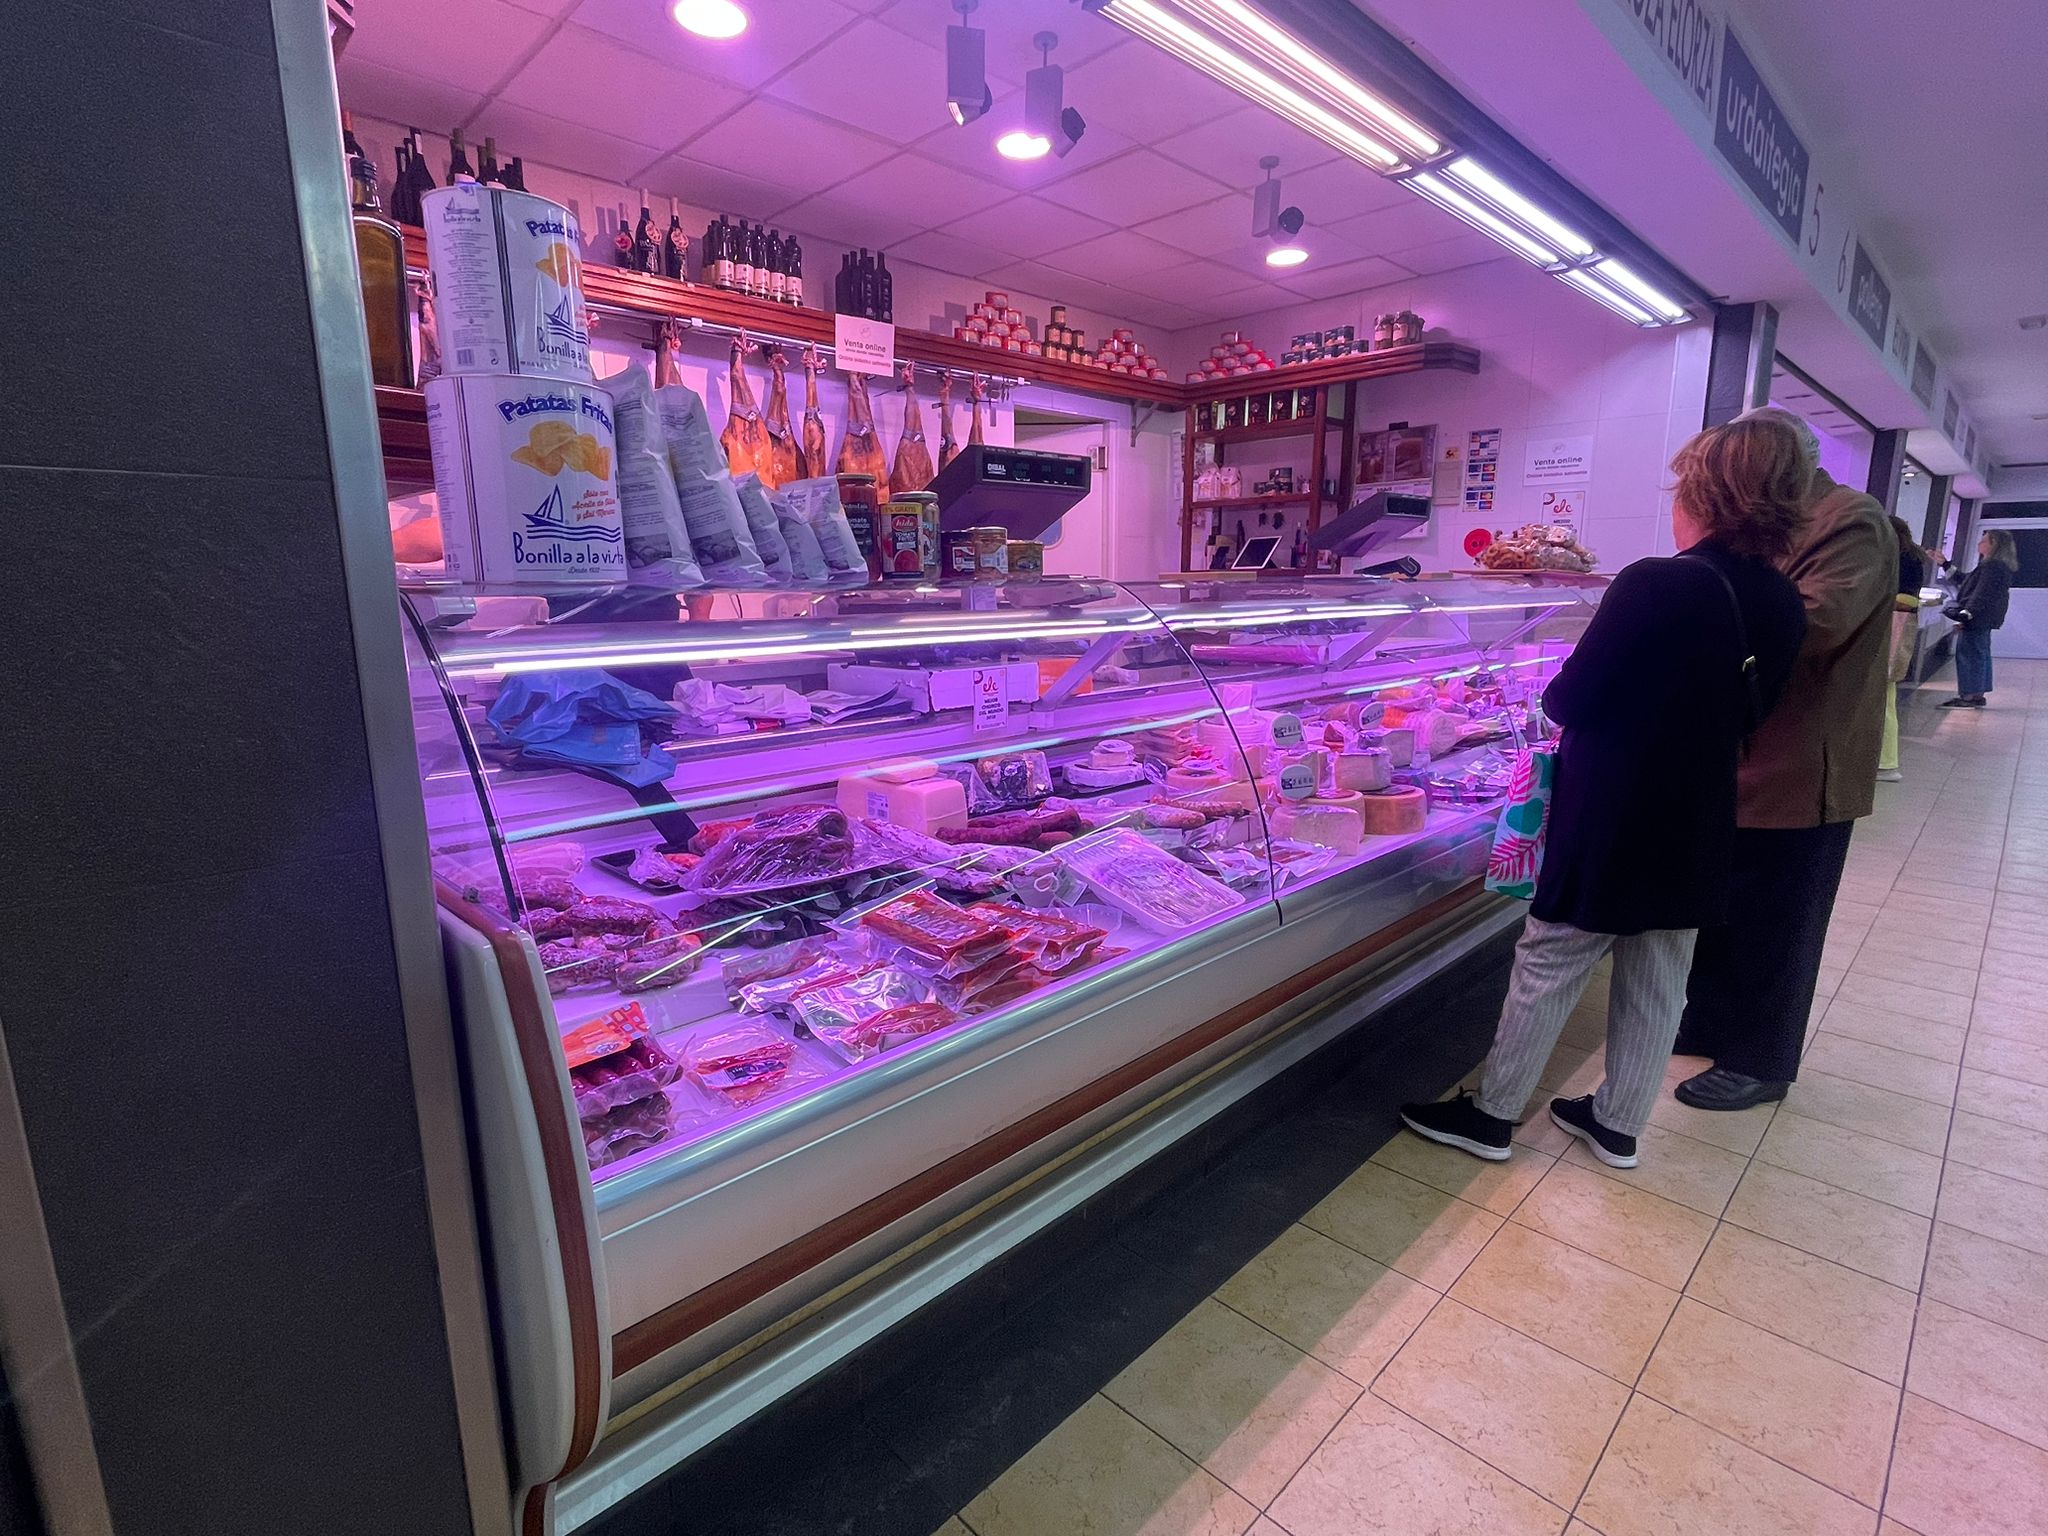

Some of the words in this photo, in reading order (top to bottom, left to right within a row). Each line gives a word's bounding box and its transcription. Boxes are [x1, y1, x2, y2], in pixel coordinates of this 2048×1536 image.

[1667, 0, 1716, 113] ELORZA
[1726, 77, 1802, 217] urdaitegia
[1808, 183, 1824, 256] 5
[1837, 229, 1850, 293] 6
[537, 326, 576, 359] Bonilla
[843, 338, 864, 349] Venta
[864, 343, 886, 353] online
[497, 394, 578, 422] Patatas
[987, 463, 1007, 472] DIBAL
[1558, 456, 1582, 464] online
[512, 531, 573, 564] Bonilla
[576, 553, 585, 564] a
[586, 543, 600, 564] la
[601, 545, 624, 565] vista
